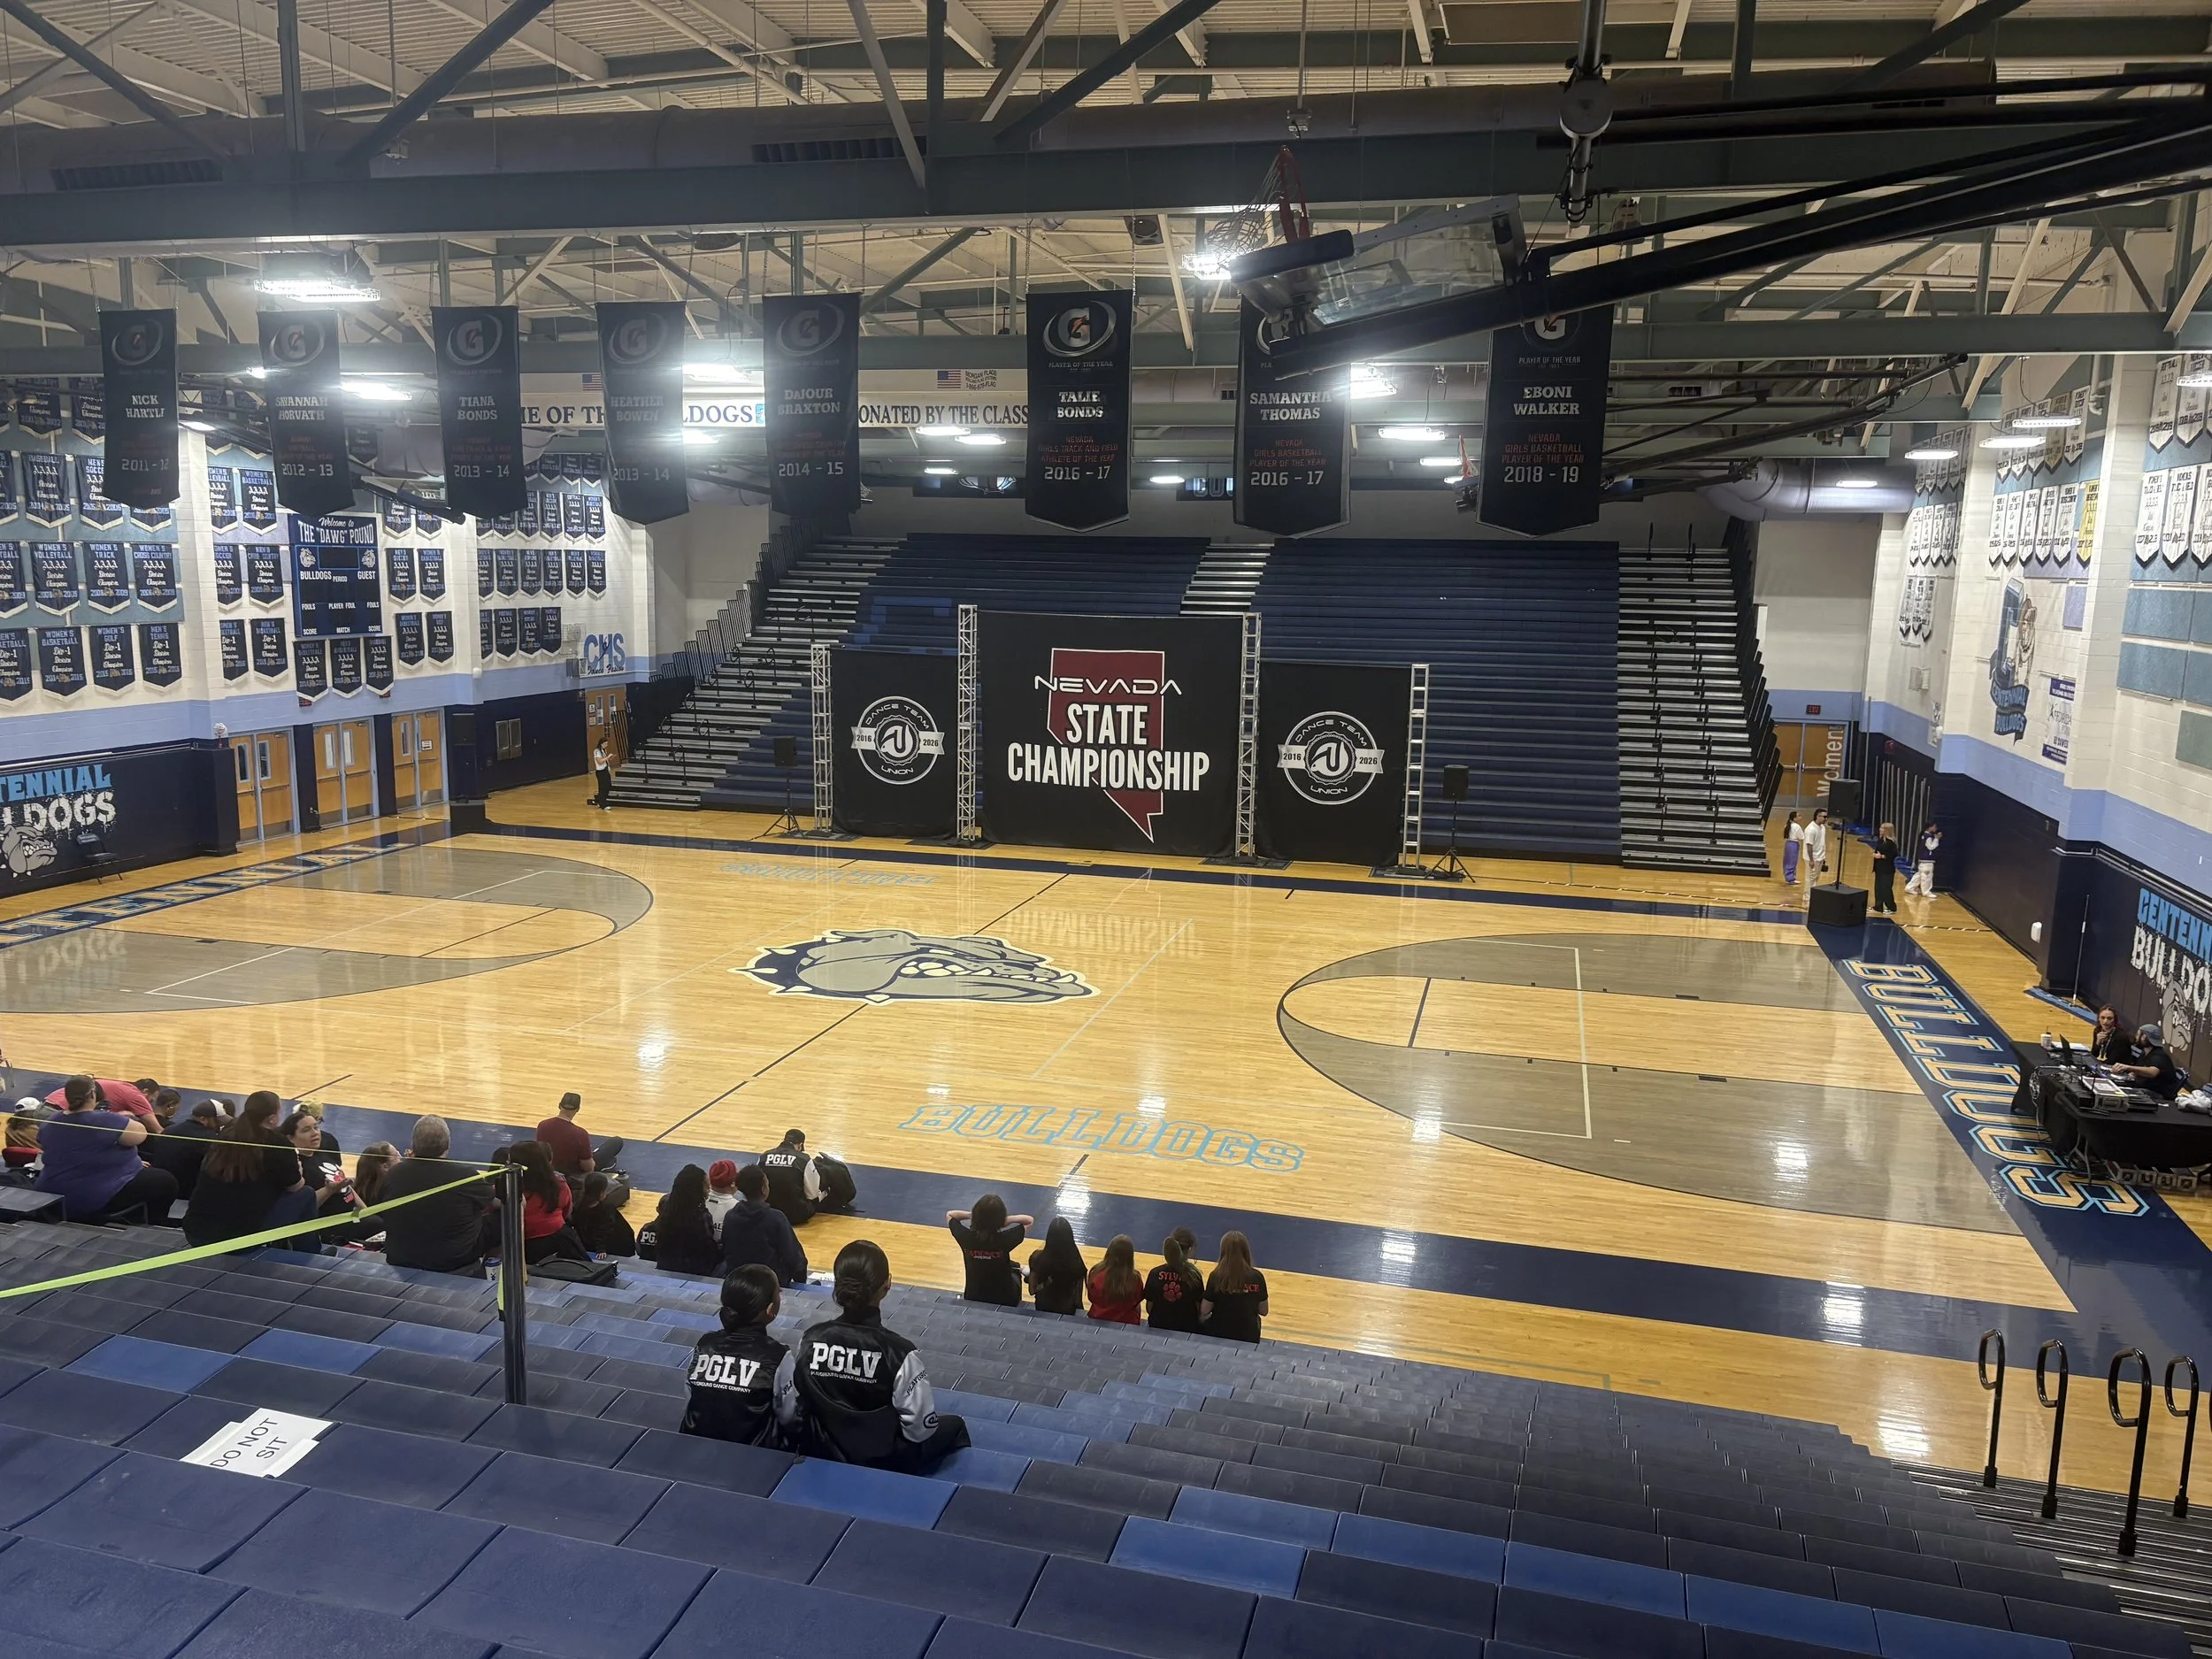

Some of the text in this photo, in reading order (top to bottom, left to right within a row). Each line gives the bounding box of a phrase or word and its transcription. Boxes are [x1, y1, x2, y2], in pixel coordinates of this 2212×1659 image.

[784, 388, 833, 400] DAJOUR
[1250, 391, 1333, 404] SAMANTHA
[1523, 387, 1572, 398] EBONI
[132, 396, 159, 405] NICK
[459, 396, 495, 407] TIANA
[611, 396, 664, 407] HEATHER
[279, 411, 326, 420] HORVATH
[457, 410, 498, 420] BONDS
[547, 406, 576, 424] OF
[858, 405, 921, 424] ONATED
[926, 406, 945, 425] BY
[949, 406, 979, 425] THE
[777, 403, 841, 415] BRAXTON
[1057, 406, 1103, 419] BONDS
[1260, 408, 1320, 420] THOMAS
[1513, 403, 1579, 415] WALKER
[616, 411, 658, 421] BOWEN
[1528, 434, 1561, 442] NEVADA
[1505, 443, 1582, 453] GIRLS BASKETBALL
[121, 458, 149, 472] 2011
[1502, 455, 1531, 464] PLAYER
[1546, 454, 1561, 463] THE
[1562, 454, 1584, 463] YEAR
[281, 463, 334, 476] 2012 13
[454, 465, 480, 478] 2013
[497, 465, 511, 478] 14
[614, 468, 671, 480] 2013 14
[779, 462, 843, 477] 2014 15
[1044, 465, 1110, 480] 2016 17
[1504, 466, 1579, 483] 2018 19
[1250, 471, 1324, 486] 2016 17
[319, 517, 347, 526] Welcome
[298, 520, 374, 544] THE "DAWG" POUND
[300, 571, 332, 580] BULLDOGS
[357, 571, 376, 580] GUEST
[42, 637, 79, 646] BASKETBALL
[584, 634, 625, 670] CHS
[1034, 675, 1182, 695] NEVADA
[865, 703, 929, 729] DANCE TEAM
[1066, 703, 1148, 745] STATE
[1295, 719, 1367, 746] DANCE TEAM
[881, 765, 914, 774] UNION
[1008, 742, 1210, 791] CHAMPIONSHIP
[1310, 785, 1348, 795] UNION
[2131, 926, 2212, 1018] BULLDO
[899, 1104, 1307, 1172] BULLDOGS
[765, 1154, 796, 1165] PGLV
[809, 1342, 882, 1379] PGLV
[689, 1354, 761, 1387] PGLV
[209, 1417, 278, 1468] DO NOT
[256, 1436, 288, 1459] SIT
